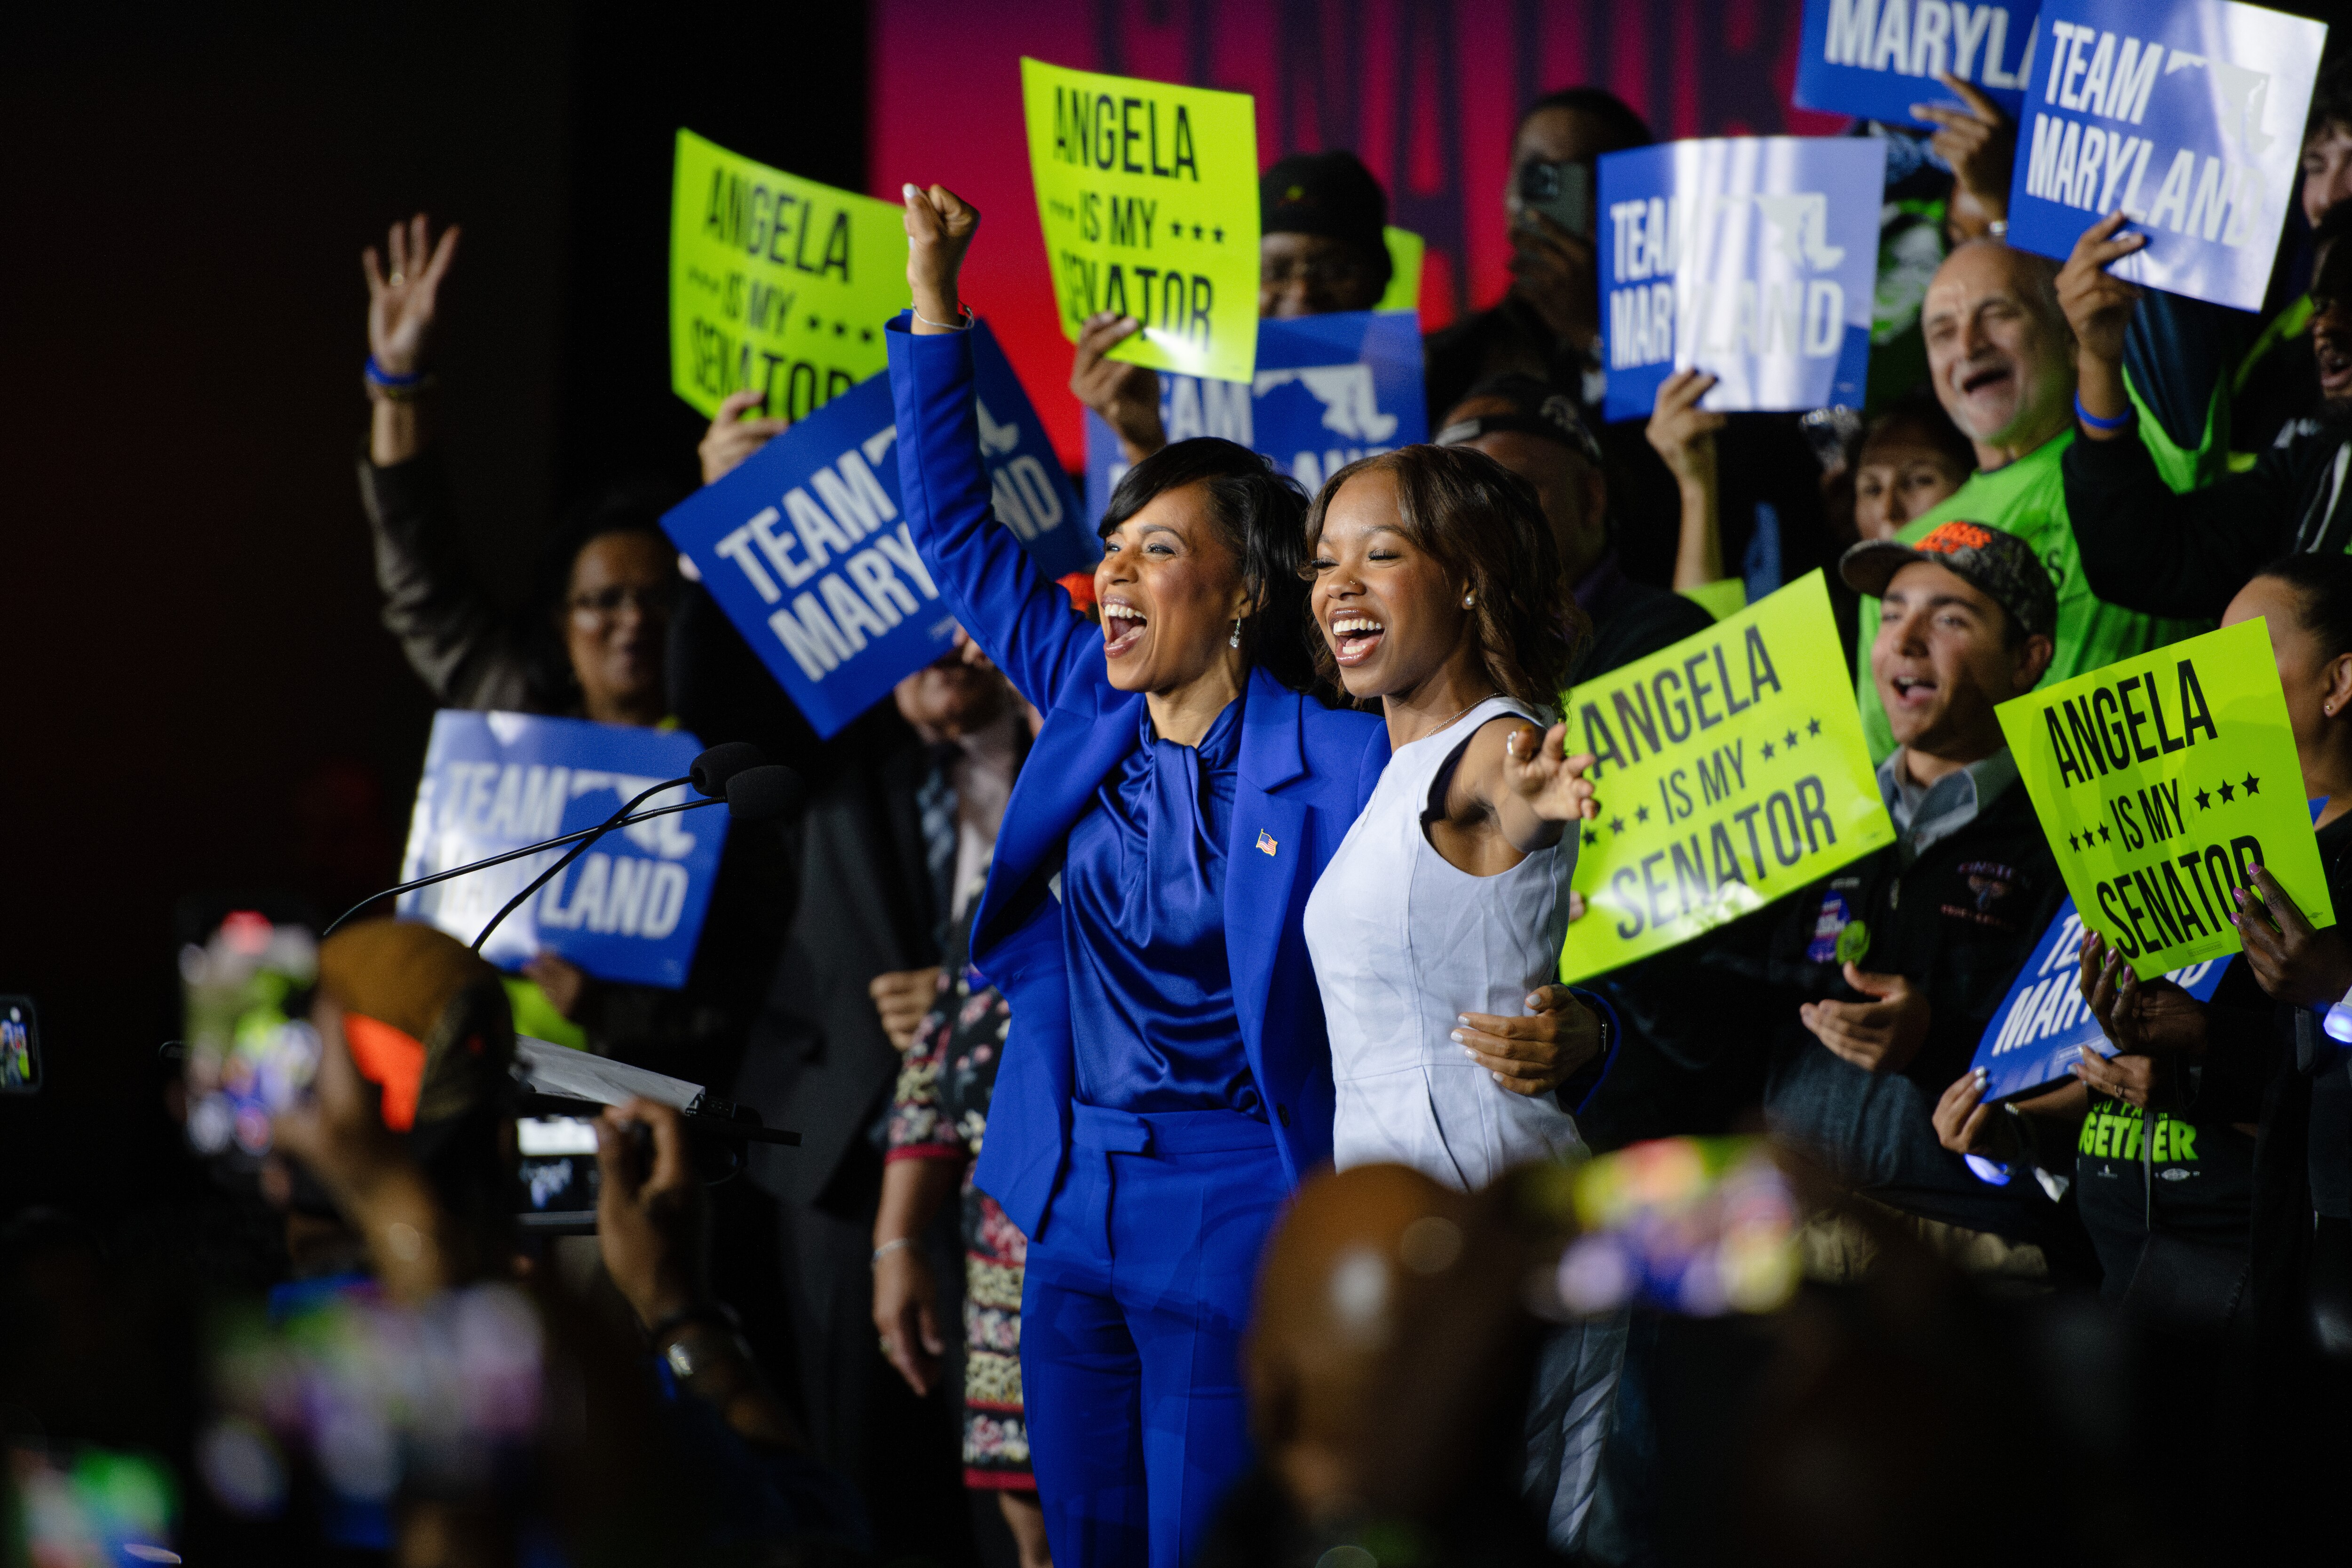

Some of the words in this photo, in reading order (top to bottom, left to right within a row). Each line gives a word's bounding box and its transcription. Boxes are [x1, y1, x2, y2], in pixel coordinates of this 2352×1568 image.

[1824, 0, 2040, 91] MARYL
[2045, 20, 2164, 125] TEAM
[1054, 85, 1200, 183] ANGELA
[2026, 112, 2266, 248] MARYLAND
[707, 167, 850, 284] ANGELA
[1081, 189, 1102, 242] IS
[1110, 194, 1158, 250] MY
[749, 278, 797, 336] MY
[1060, 248, 1214, 354] SENATOR
[1609, 279, 1844, 370] MARLAND
[1158, 374, 1254, 447] AM
[714, 449, 898, 604] TEAM
[1580, 622, 1783, 780] ANGELA
[2043, 659, 2218, 788] ANGELA
[437, 763, 567, 837] TEAM
[1659, 768, 1693, 825] IS
[1697, 738, 1747, 806] MY
[2109, 795, 2144, 852] IS
[2137, 778, 2185, 844] MY
[420, 847, 689, 939] LAND
[1612, 774, 1836, 940] SENATOR
[2097, 835, 2265, 959] SENATOR
[2038, 913, 2084, 977] TE
[2078, 1111, 2198, 1162] GETHER
